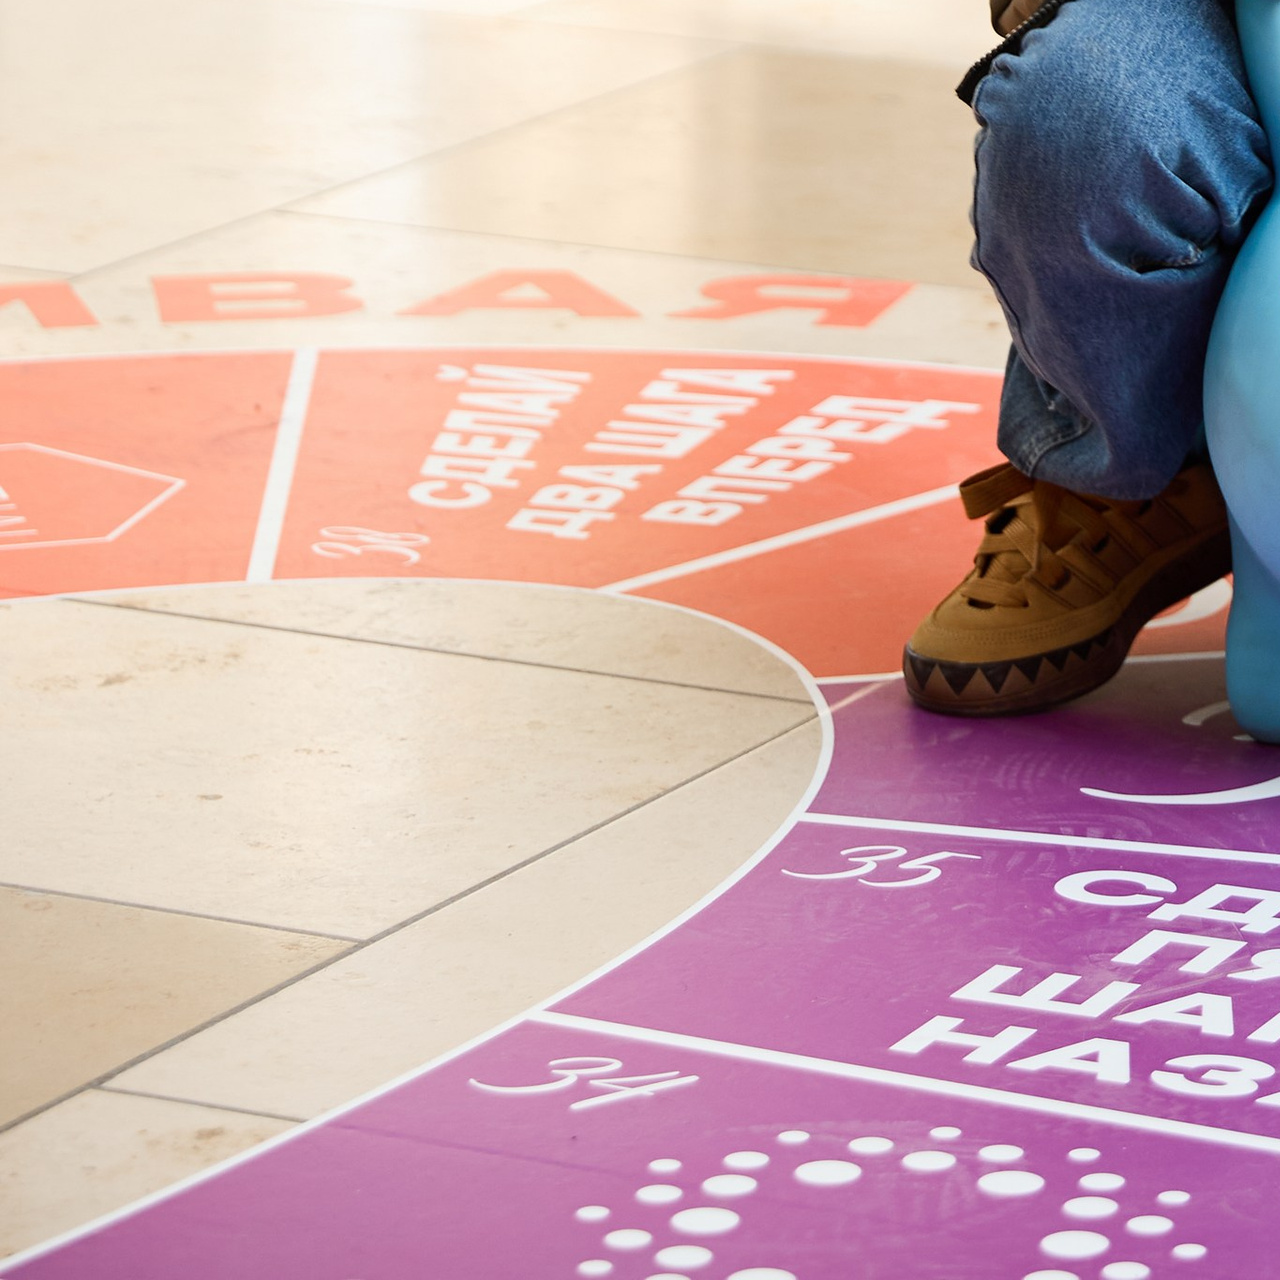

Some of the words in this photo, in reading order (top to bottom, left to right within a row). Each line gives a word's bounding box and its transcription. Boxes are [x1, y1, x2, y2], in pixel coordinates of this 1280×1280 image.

[407, 363, 593, 509] СДЕЛАЙ
[583, 367, 796, 459] ШАГА
[641, 395, 981, 526] ВПЕРЕД
[505, 463, 663, 539] ДВА
[311, 525, 430, 566] 38
[781, 845, 982, 888] 35
[467, 1056, 700, 1111] 34
